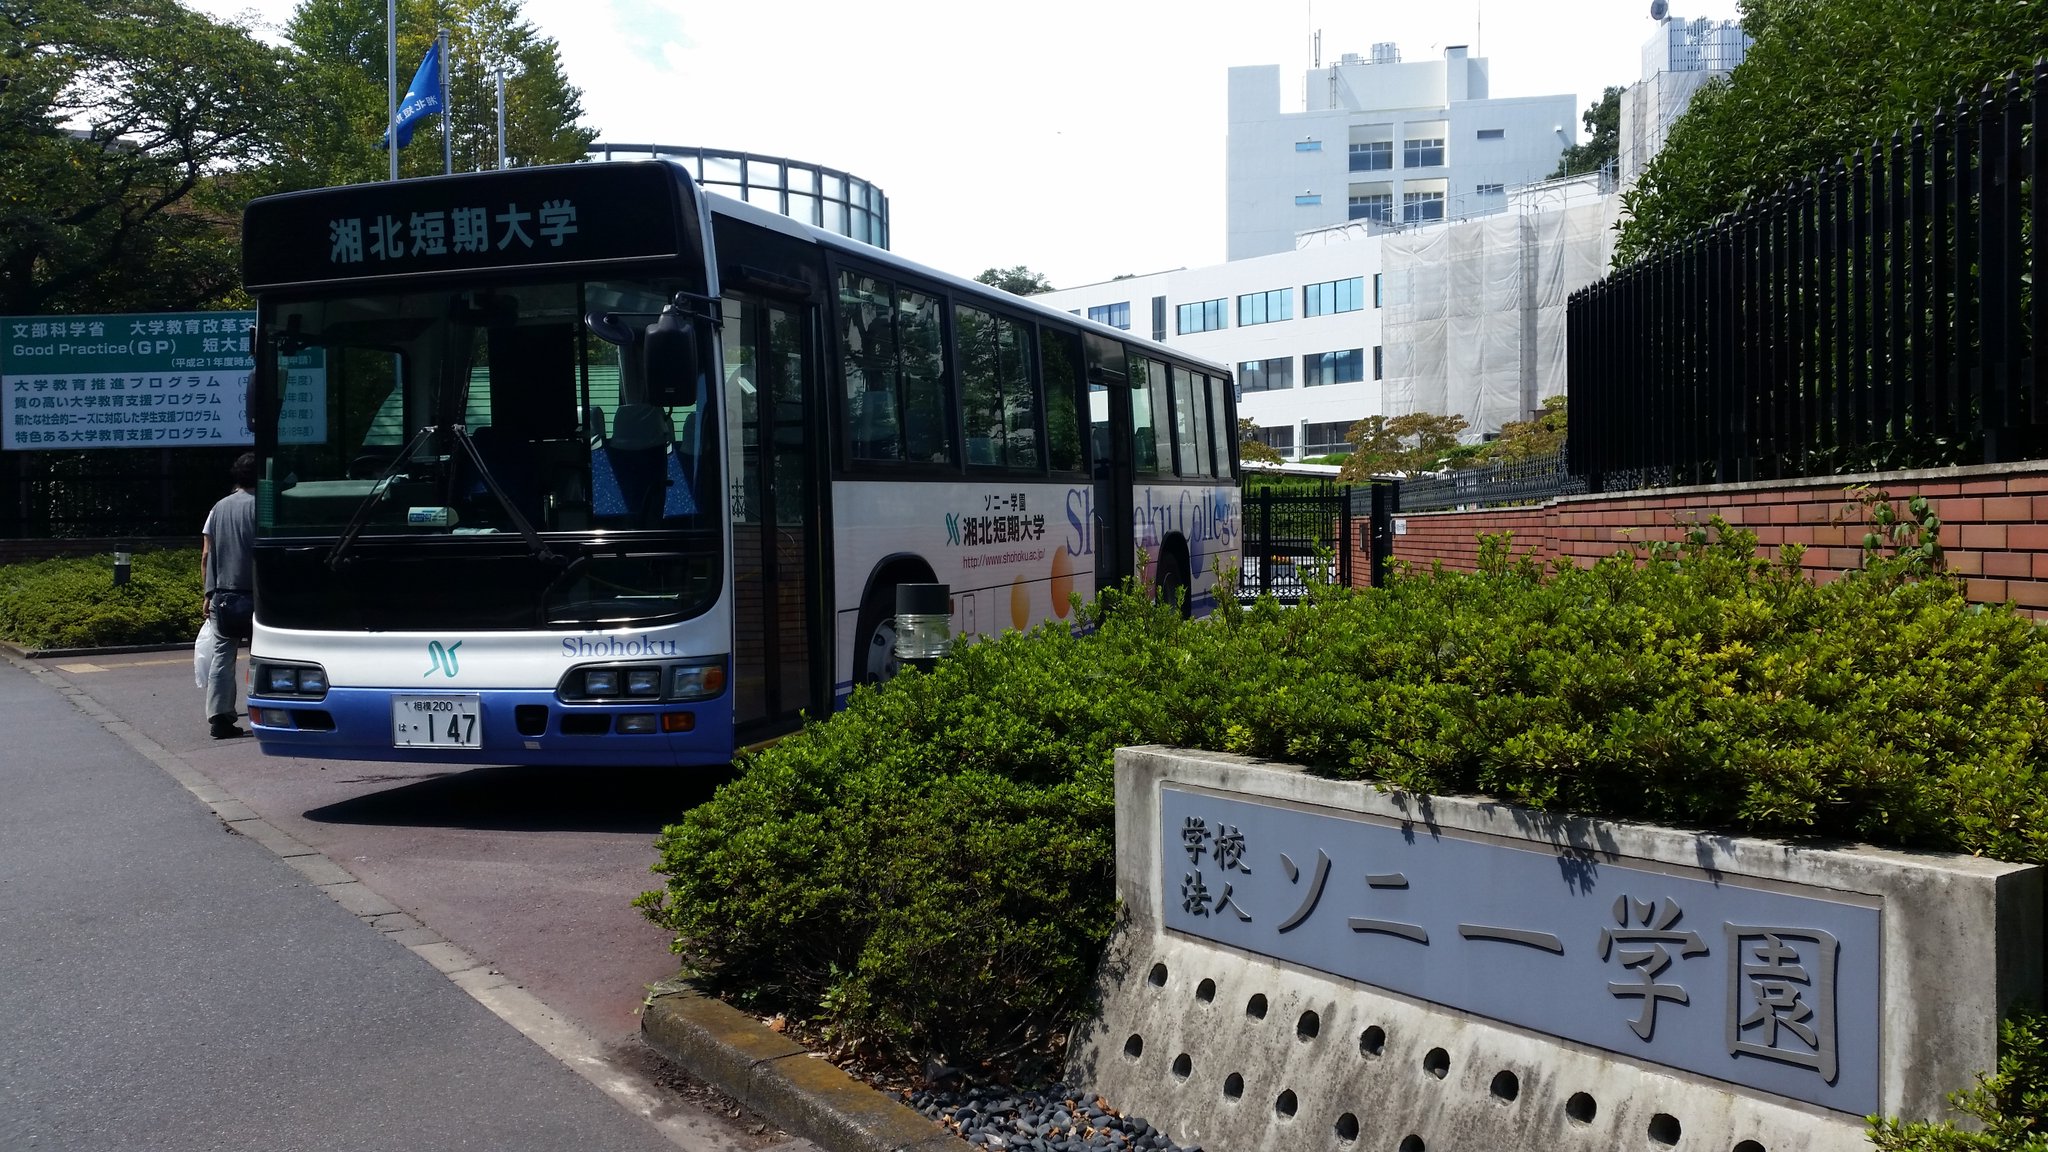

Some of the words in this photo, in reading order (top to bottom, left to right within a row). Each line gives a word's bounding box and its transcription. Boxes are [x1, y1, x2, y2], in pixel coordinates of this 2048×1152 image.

[329, 199, 578, 264] 湘北短期大学
[12, 321, 105, 338] 文部科学省
[13, 344, 54, 356] Good
[14, 375, 221, 392] 大学教育推進プログラム
[14, 393, 222, 409] 質の高い大学教育支援プログラム
[15, 427, 222, 443] 特色ある大学教育支援プログラム
[984, 493, 1026, 512] ソニー学園
[963, 514, 1045, 547] 湘北短期大学
[561, 634, 678, 658] Shohoku
[1278, 847, 1840, 1084] ソニー学園
